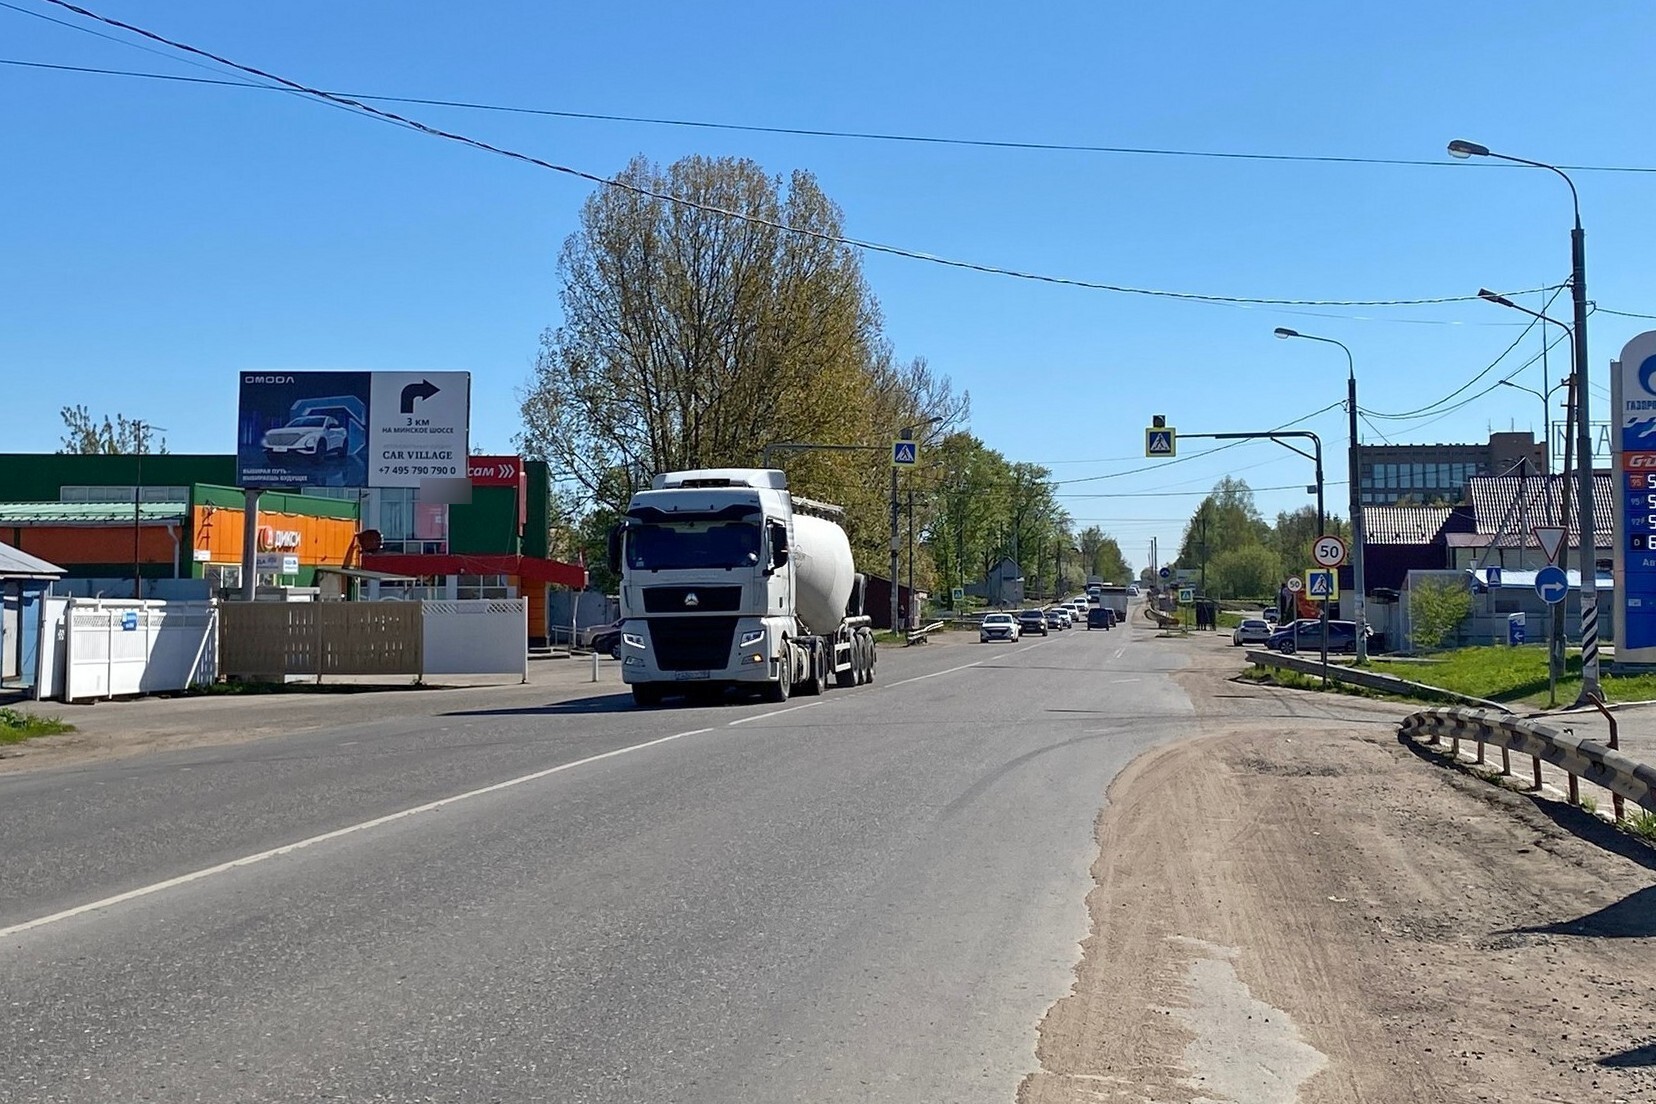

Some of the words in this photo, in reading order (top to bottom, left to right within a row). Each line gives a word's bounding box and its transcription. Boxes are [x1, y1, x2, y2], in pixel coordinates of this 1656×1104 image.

[245, 376, 295, 384] OMODA
[407, 418, 412, 426] 3
[382, 451, 404, 459] CAR
[407, 451, 453, 459] VILLAGE
[379, 466, 389, 475] +7
[392, 466, 409, 475] 495
[412, 466, 428, 475] 790
[431, 466, 447, 475] 790
[450, 466, 456, 475] 0
[1320, 546, 1338, 558] 50
